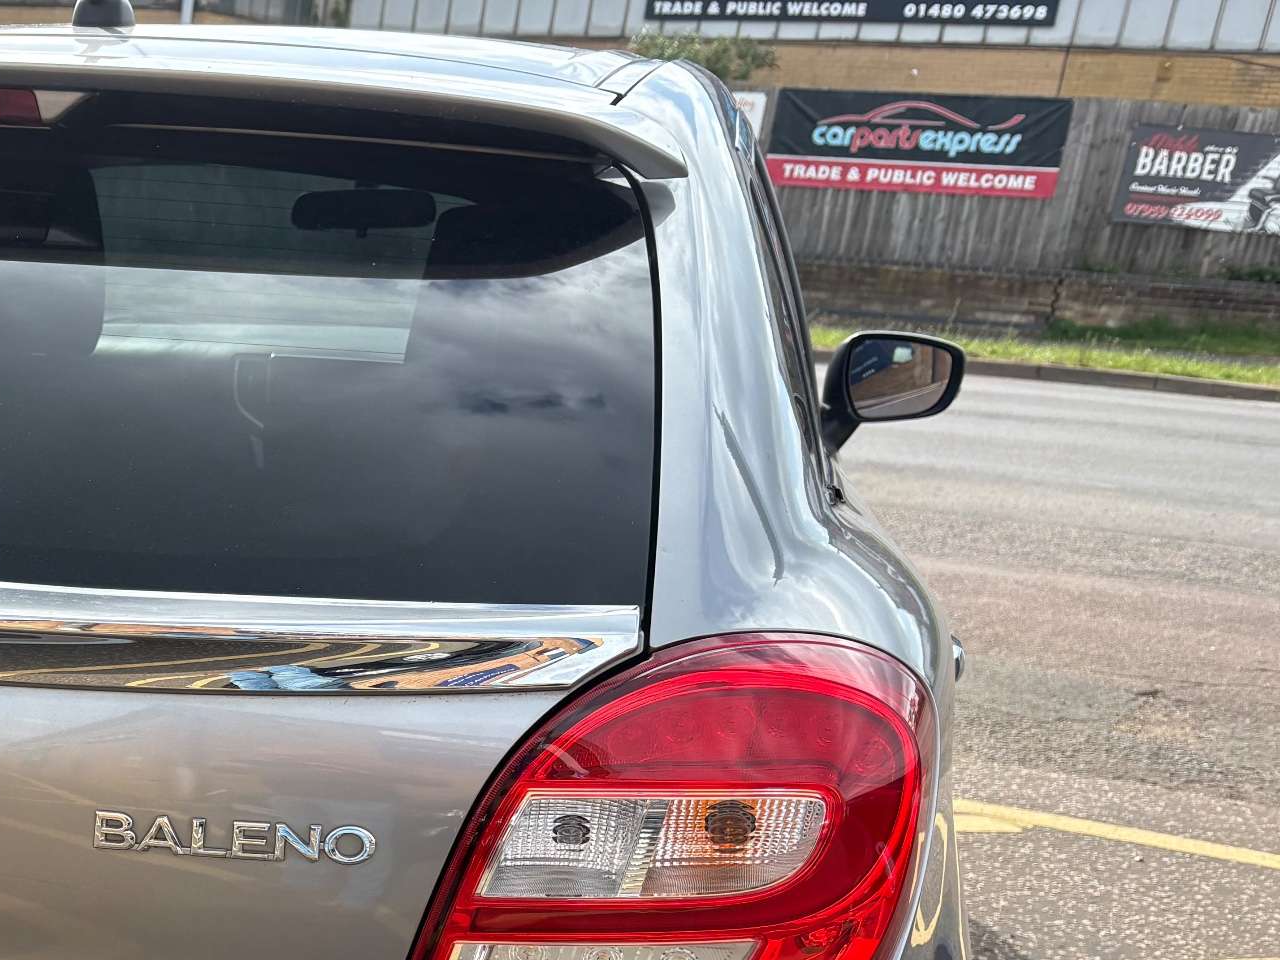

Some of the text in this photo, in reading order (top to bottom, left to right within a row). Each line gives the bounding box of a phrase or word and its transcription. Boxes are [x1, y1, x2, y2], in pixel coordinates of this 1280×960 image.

[653, 1, 1048, 20] TRADE & PUBLIC WELCOME 01480 473698
[783, 163, 1037, 190] TRADE & PUBLIC WELCOME
[1134, 146, 1237, 183] BARBER
[93, 809, 377, 865] BALENO
